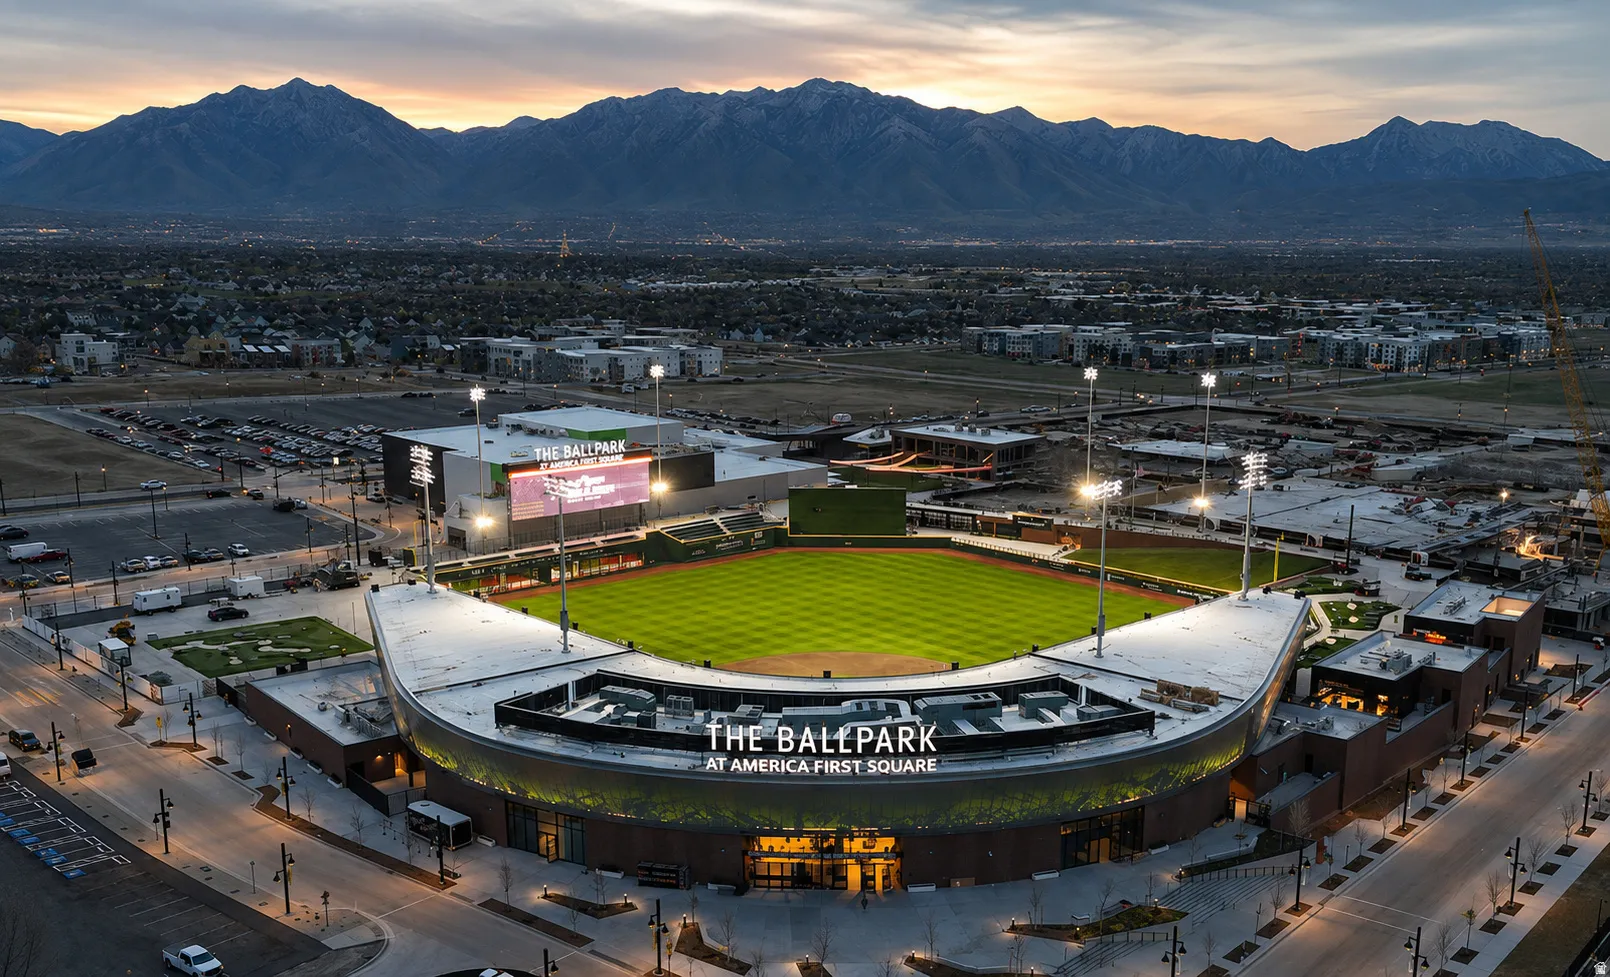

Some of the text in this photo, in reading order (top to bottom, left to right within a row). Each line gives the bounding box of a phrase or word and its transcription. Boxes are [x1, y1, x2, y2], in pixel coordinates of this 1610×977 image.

[534, 439, 626, 462] THE BALLPARK
[550, 459, 579, 469] AMERICA
[705, 724, 937, 754] THE BALLPARK
[705, 757, 937, 774] AT AMERICA FIRST SQUARE
